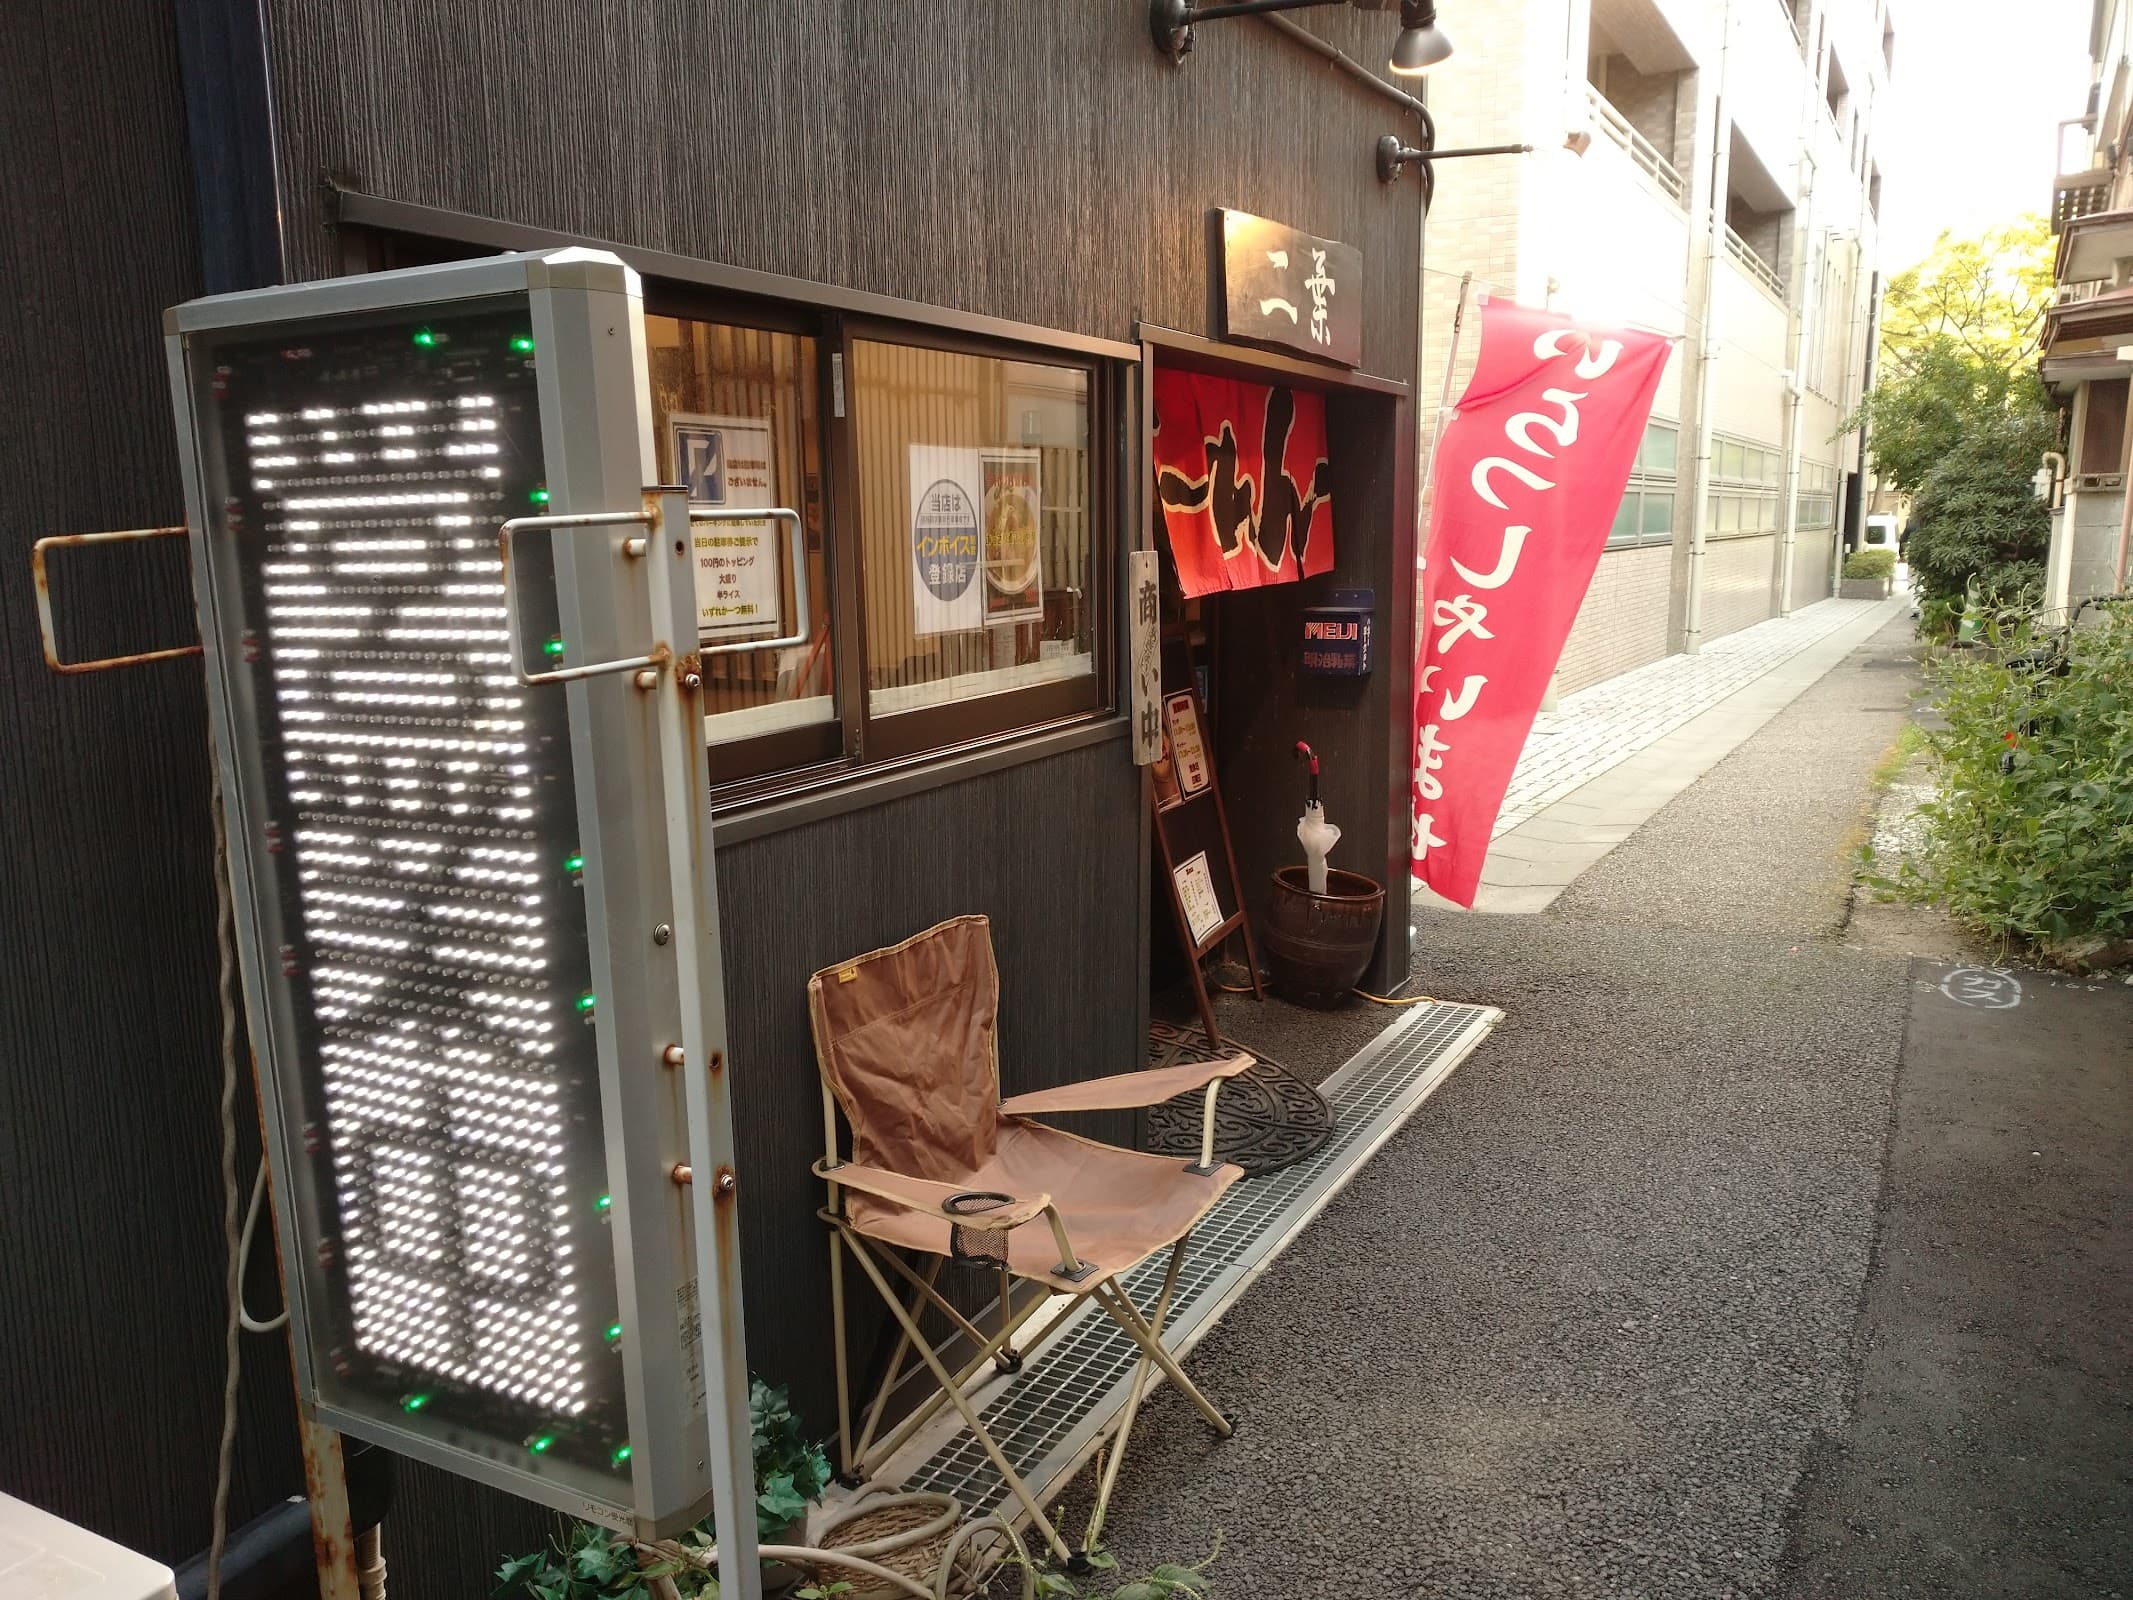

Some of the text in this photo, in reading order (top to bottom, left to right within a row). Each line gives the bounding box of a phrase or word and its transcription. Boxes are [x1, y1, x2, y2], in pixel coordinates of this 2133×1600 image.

[931, 493, 961, 513] 当店は
[700, 555, 754, 568] 100円のトッピング
[719, 574, 736, 584] 大盛り
[929, 562, 967, 585] 登録店
[717, 590, 740, 600] 半ライス
[1304, 622, 1358, 641] MEIJI
[1139, 579, 1159, 749] 商い中
[252, 394, 564, 1385] 営業中
